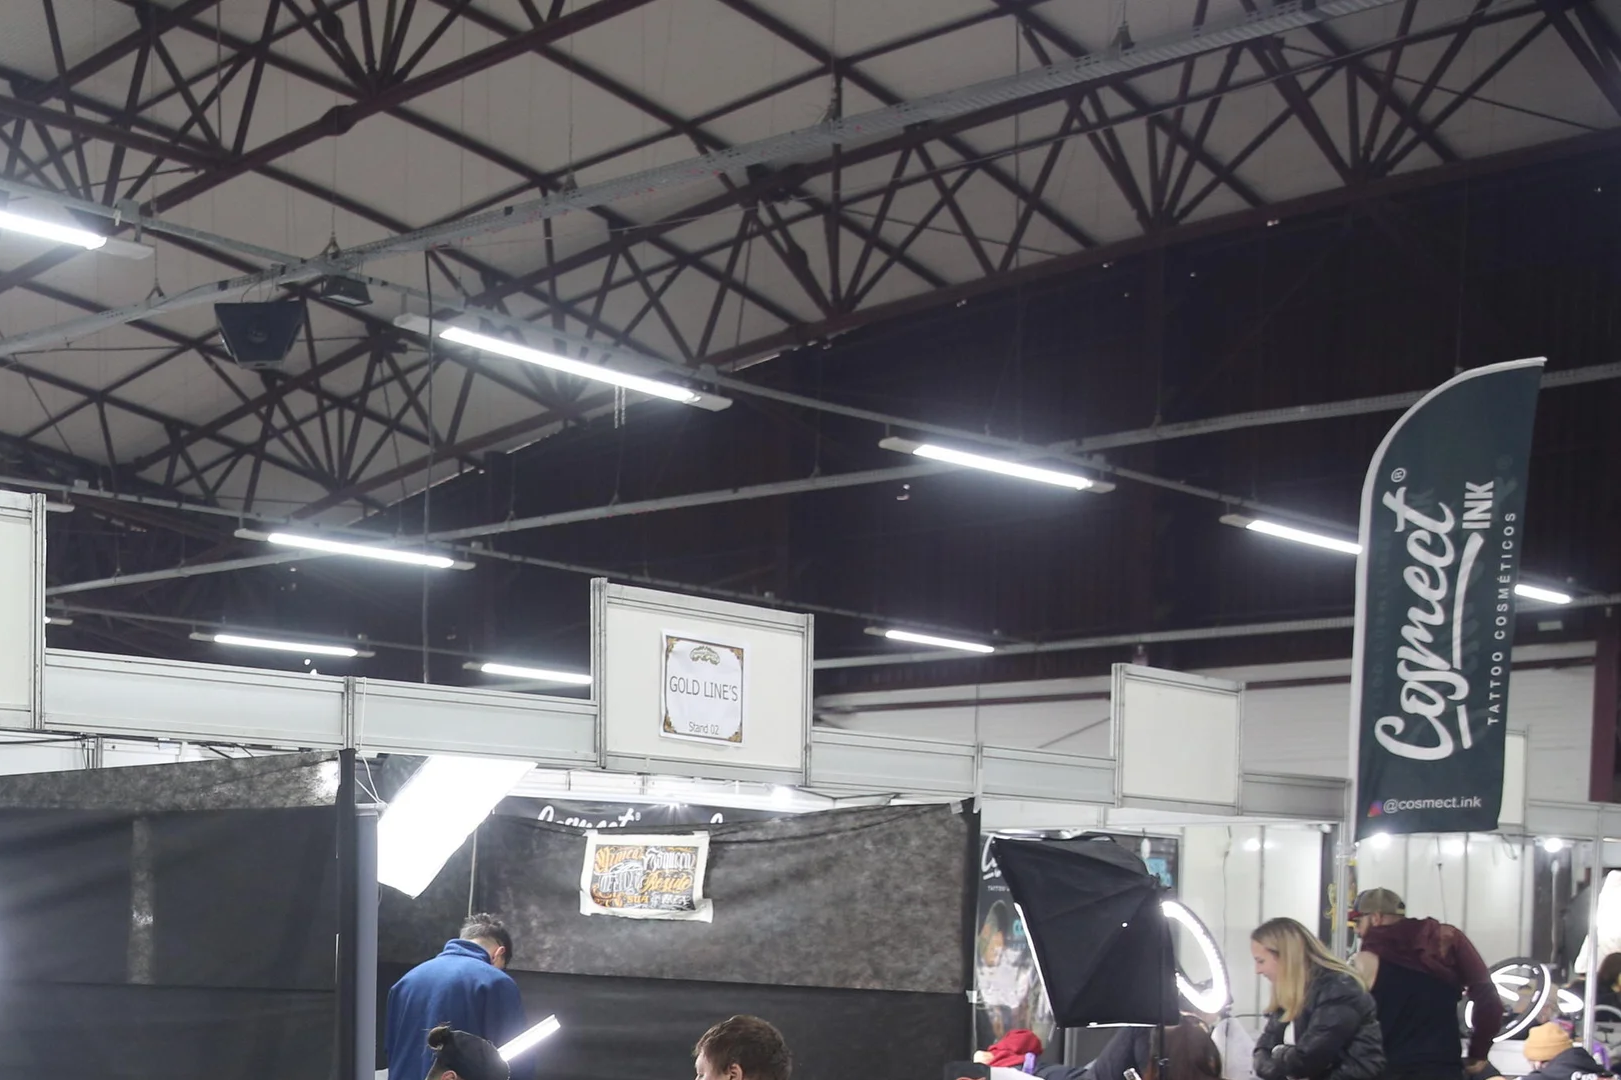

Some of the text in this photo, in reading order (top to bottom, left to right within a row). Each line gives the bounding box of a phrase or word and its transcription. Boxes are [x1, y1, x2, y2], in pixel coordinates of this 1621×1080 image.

[1375, 481, 1494, 761] Cosmect INK
[1487, 512, 1516, 726] TATTOO COSMÉTICOS
[670, 676, 738, 702] GOLD LINE'S
[689, 722, 719, 735] Stand 02
[1383, 796, 1481, 815] @cosmect.ink
